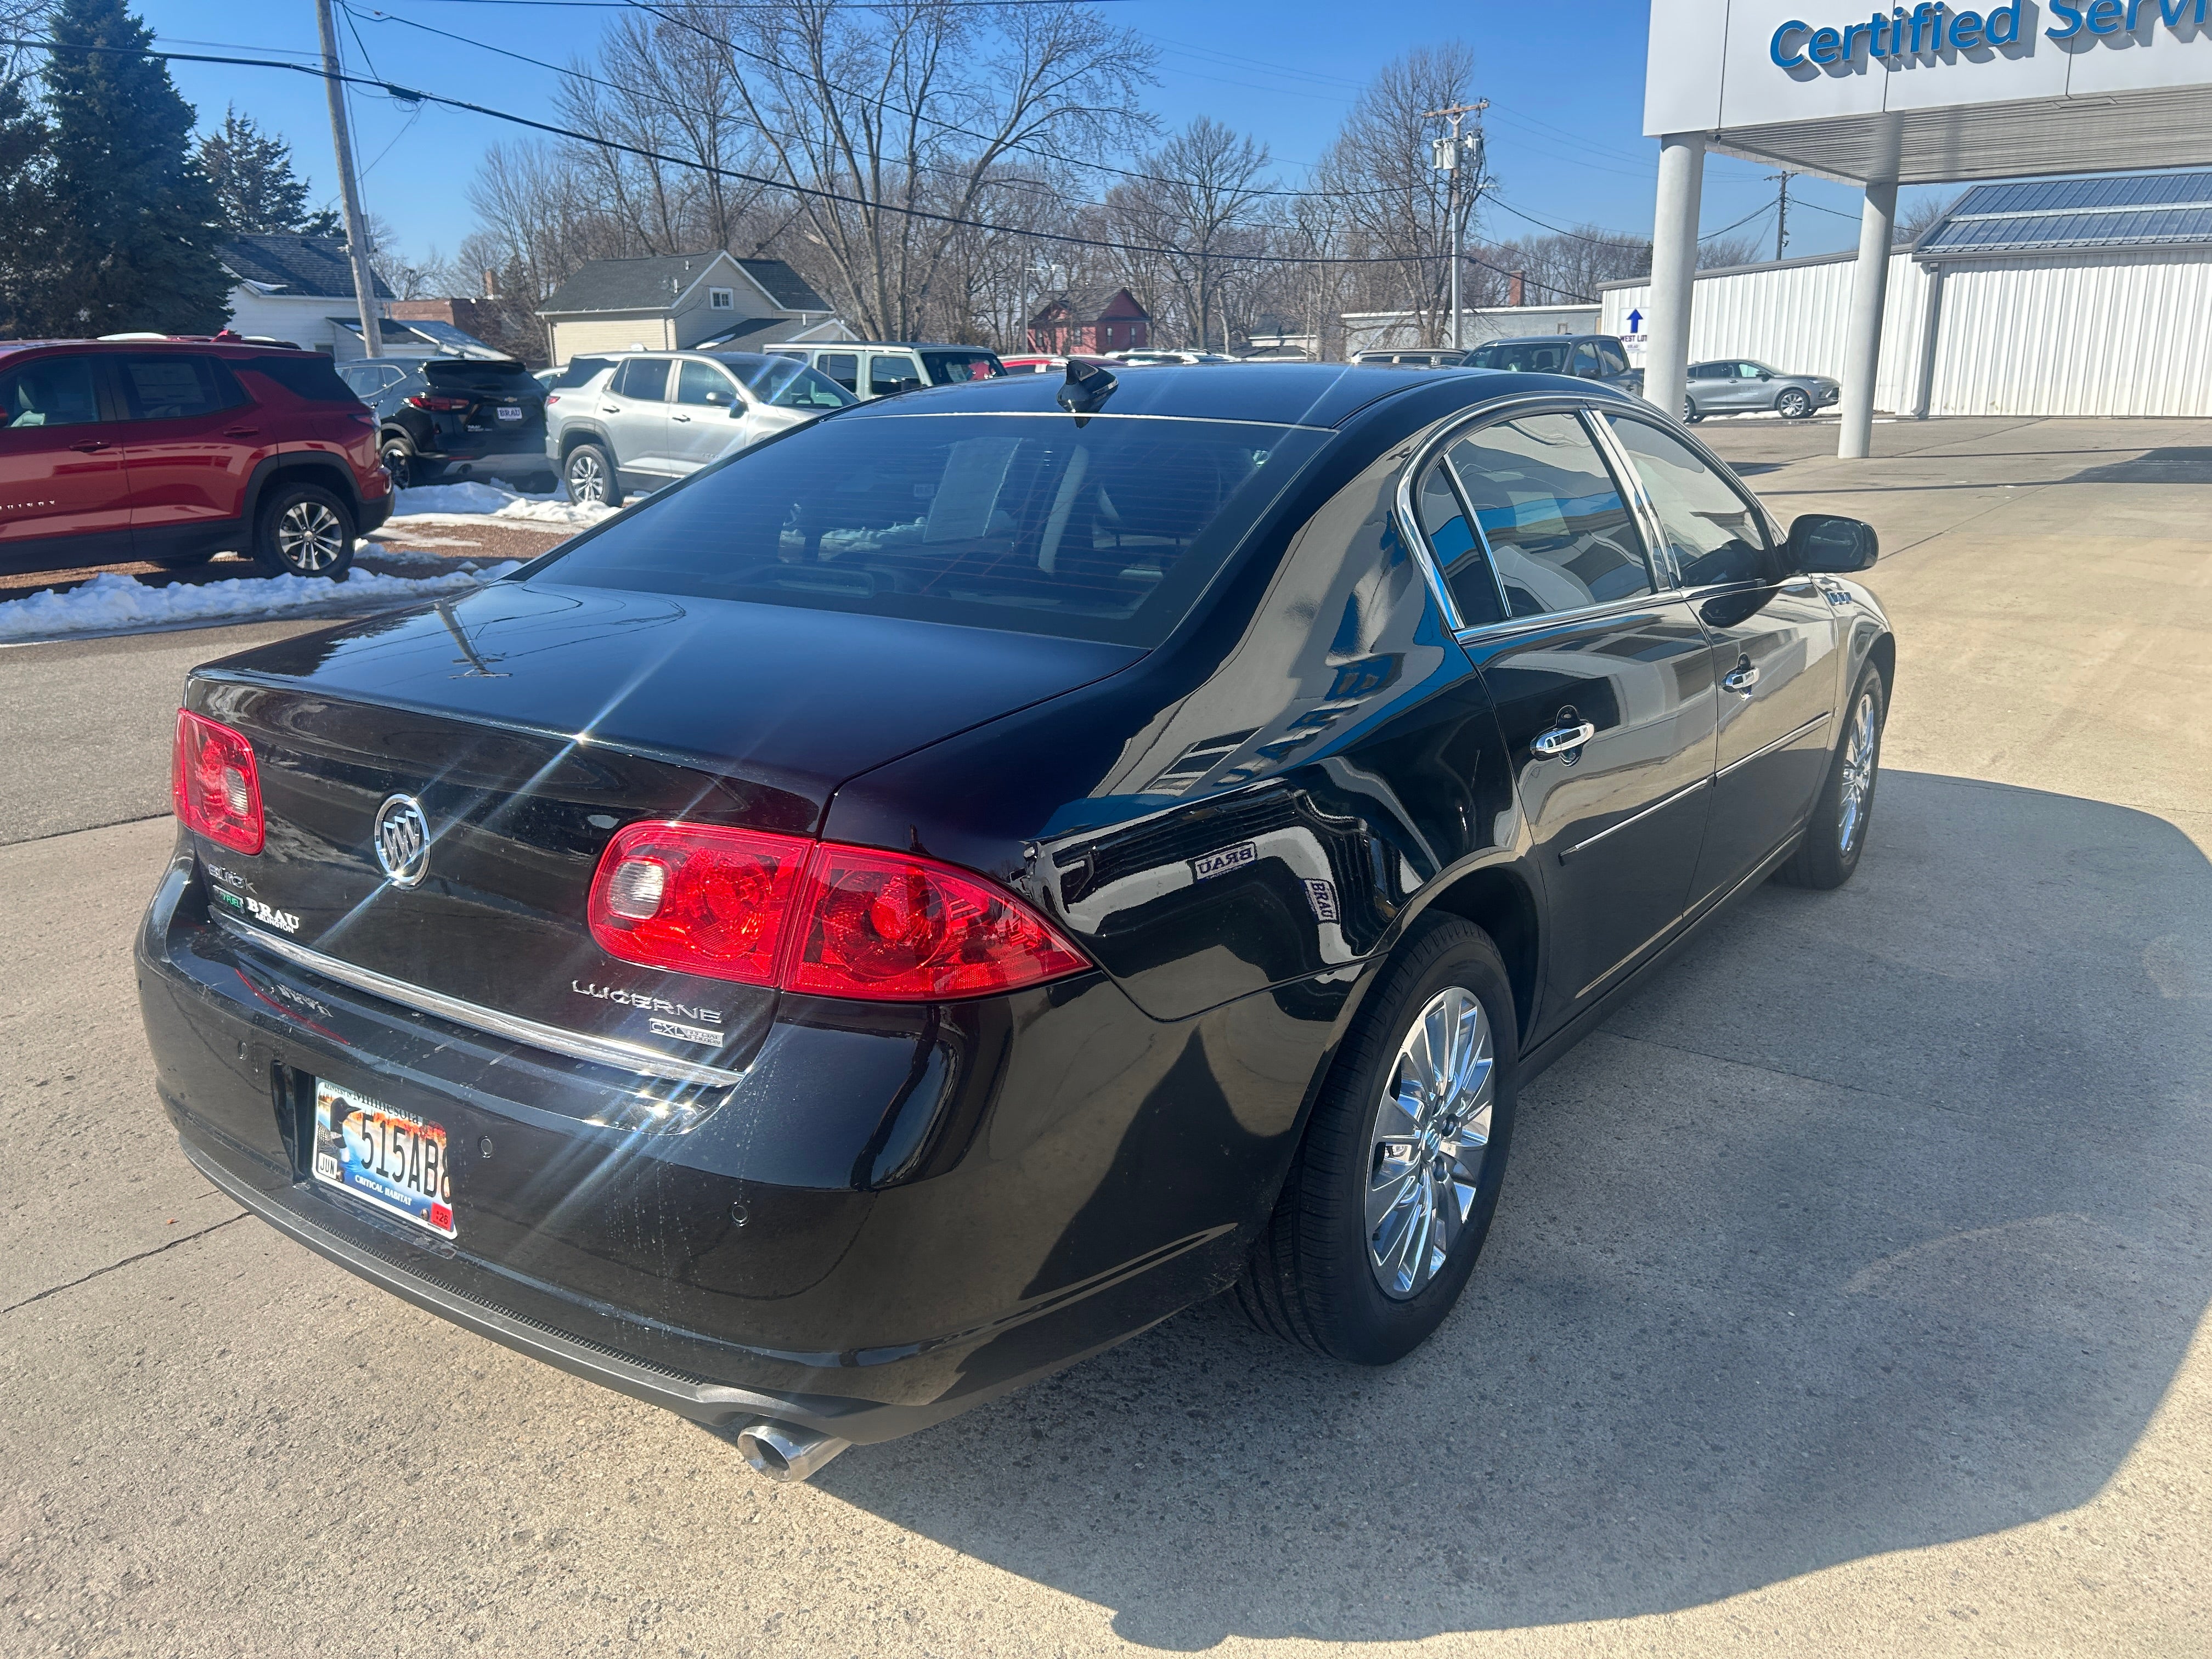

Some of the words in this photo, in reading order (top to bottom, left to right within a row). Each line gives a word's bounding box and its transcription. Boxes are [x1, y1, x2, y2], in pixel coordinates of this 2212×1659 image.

[1770, 0, 2023, 69] Certified
[2044, 0, 2212, 38] Servi
[208, 864, 257, 894] BUICK
[246, 896, 300, 930] BRAU
[1310, 882, 1334, 918] BRAU
[255, 912, 295, 934] ARLINGTON
[572, 980, 723, 1024] LUCERNE
[652, 1022, 685, 1037] CXL
[353, 1091, 419, 1124] Minnesota
[320, 1157, 335, 1176] JUN
[354, 1174, 384, 1194] CRITICAL
[385, 1187, 413, 1206] HABITAT
[439, 1212, 449, 1224] 26
